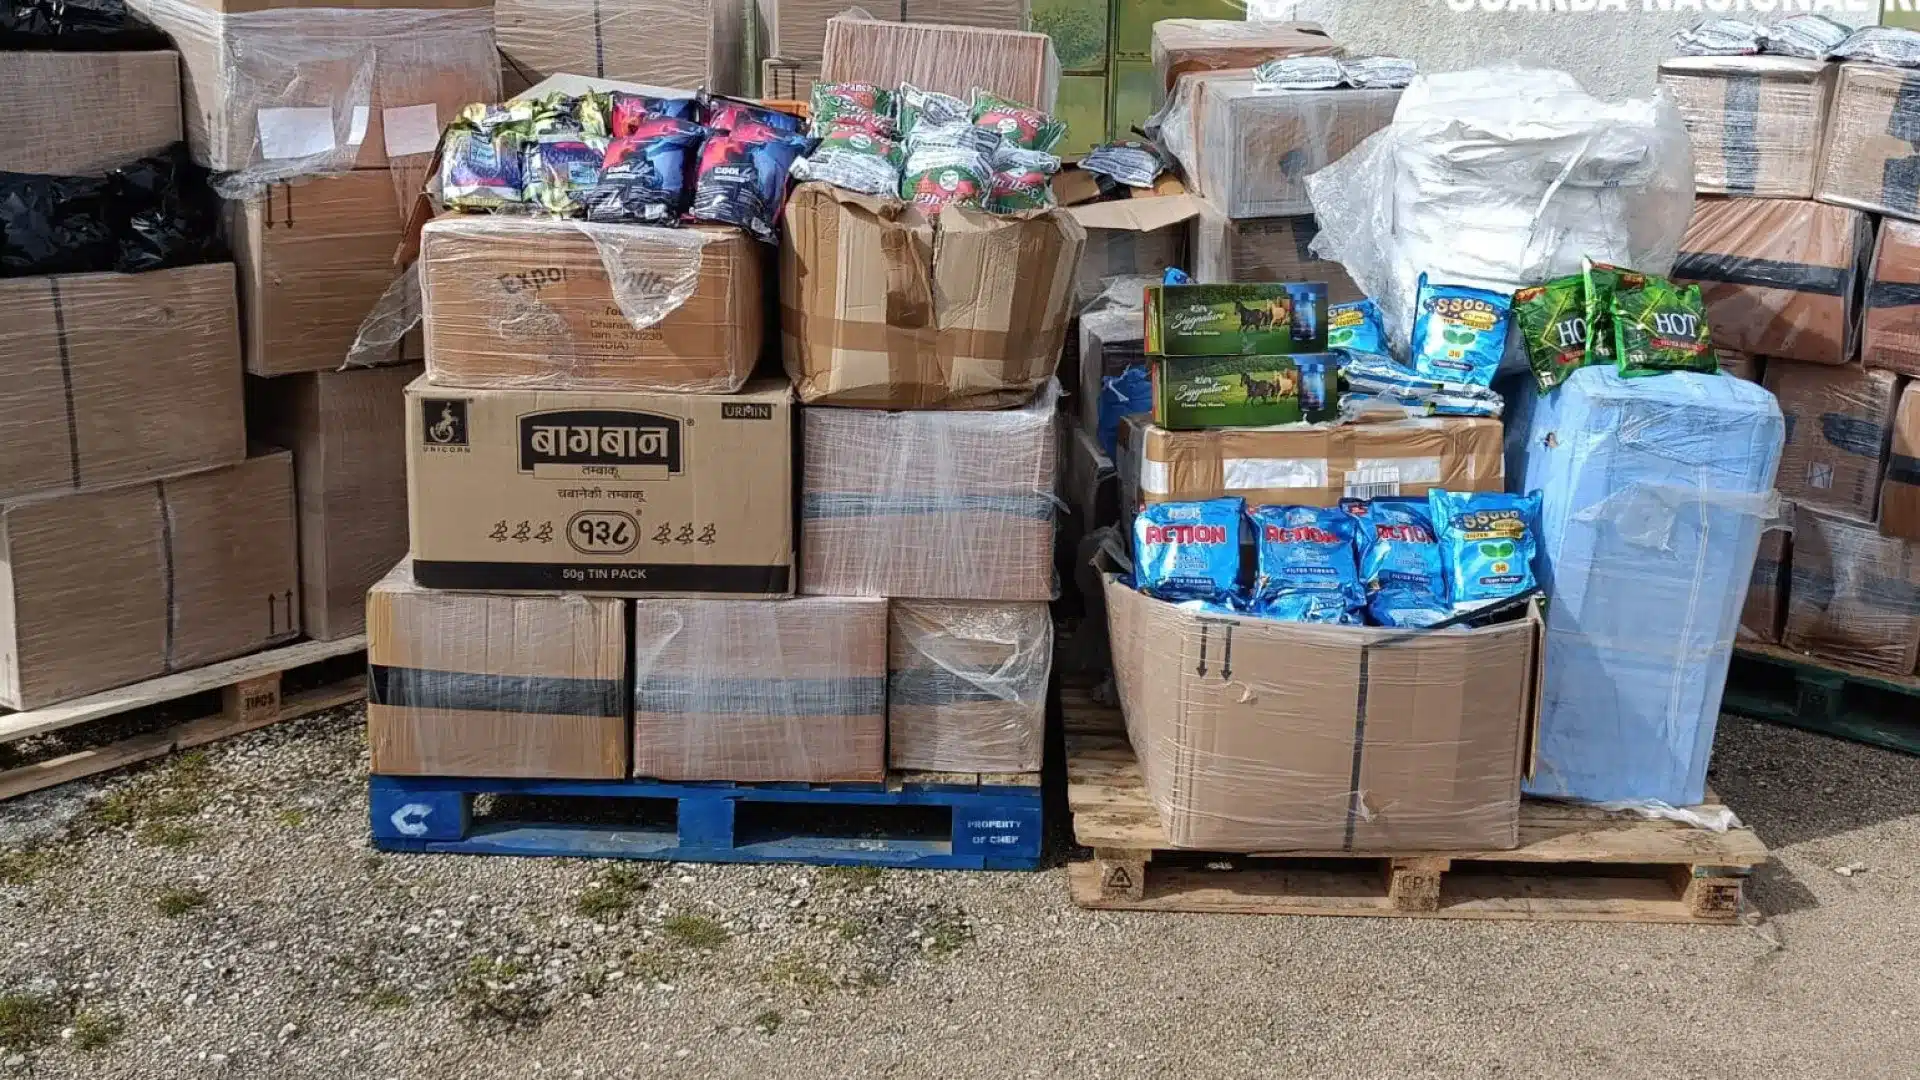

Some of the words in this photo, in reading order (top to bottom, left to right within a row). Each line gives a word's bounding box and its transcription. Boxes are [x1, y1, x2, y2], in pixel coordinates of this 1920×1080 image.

[1557, 317, 1586, 346] HO
[1655, 312, 1698, 337] HOT
[724, 404, 769, 417] URMIN
[531, 425, 669, 458] बागबान
[607, 489, 647, 503] तम्बाकू
[578, 519, 630, 545] १३८
[1145, 525, 1226, 544] ACTION
[562, 569, 584, 581] 50g
[588, 569, 608, 579] TIN
[611, 569, 647, 579] PACK
[967, 820, 1022, 828] PROPERTY
[972, 836, 986, 844] OF
[989, 836, 1020, 844] CHEF
